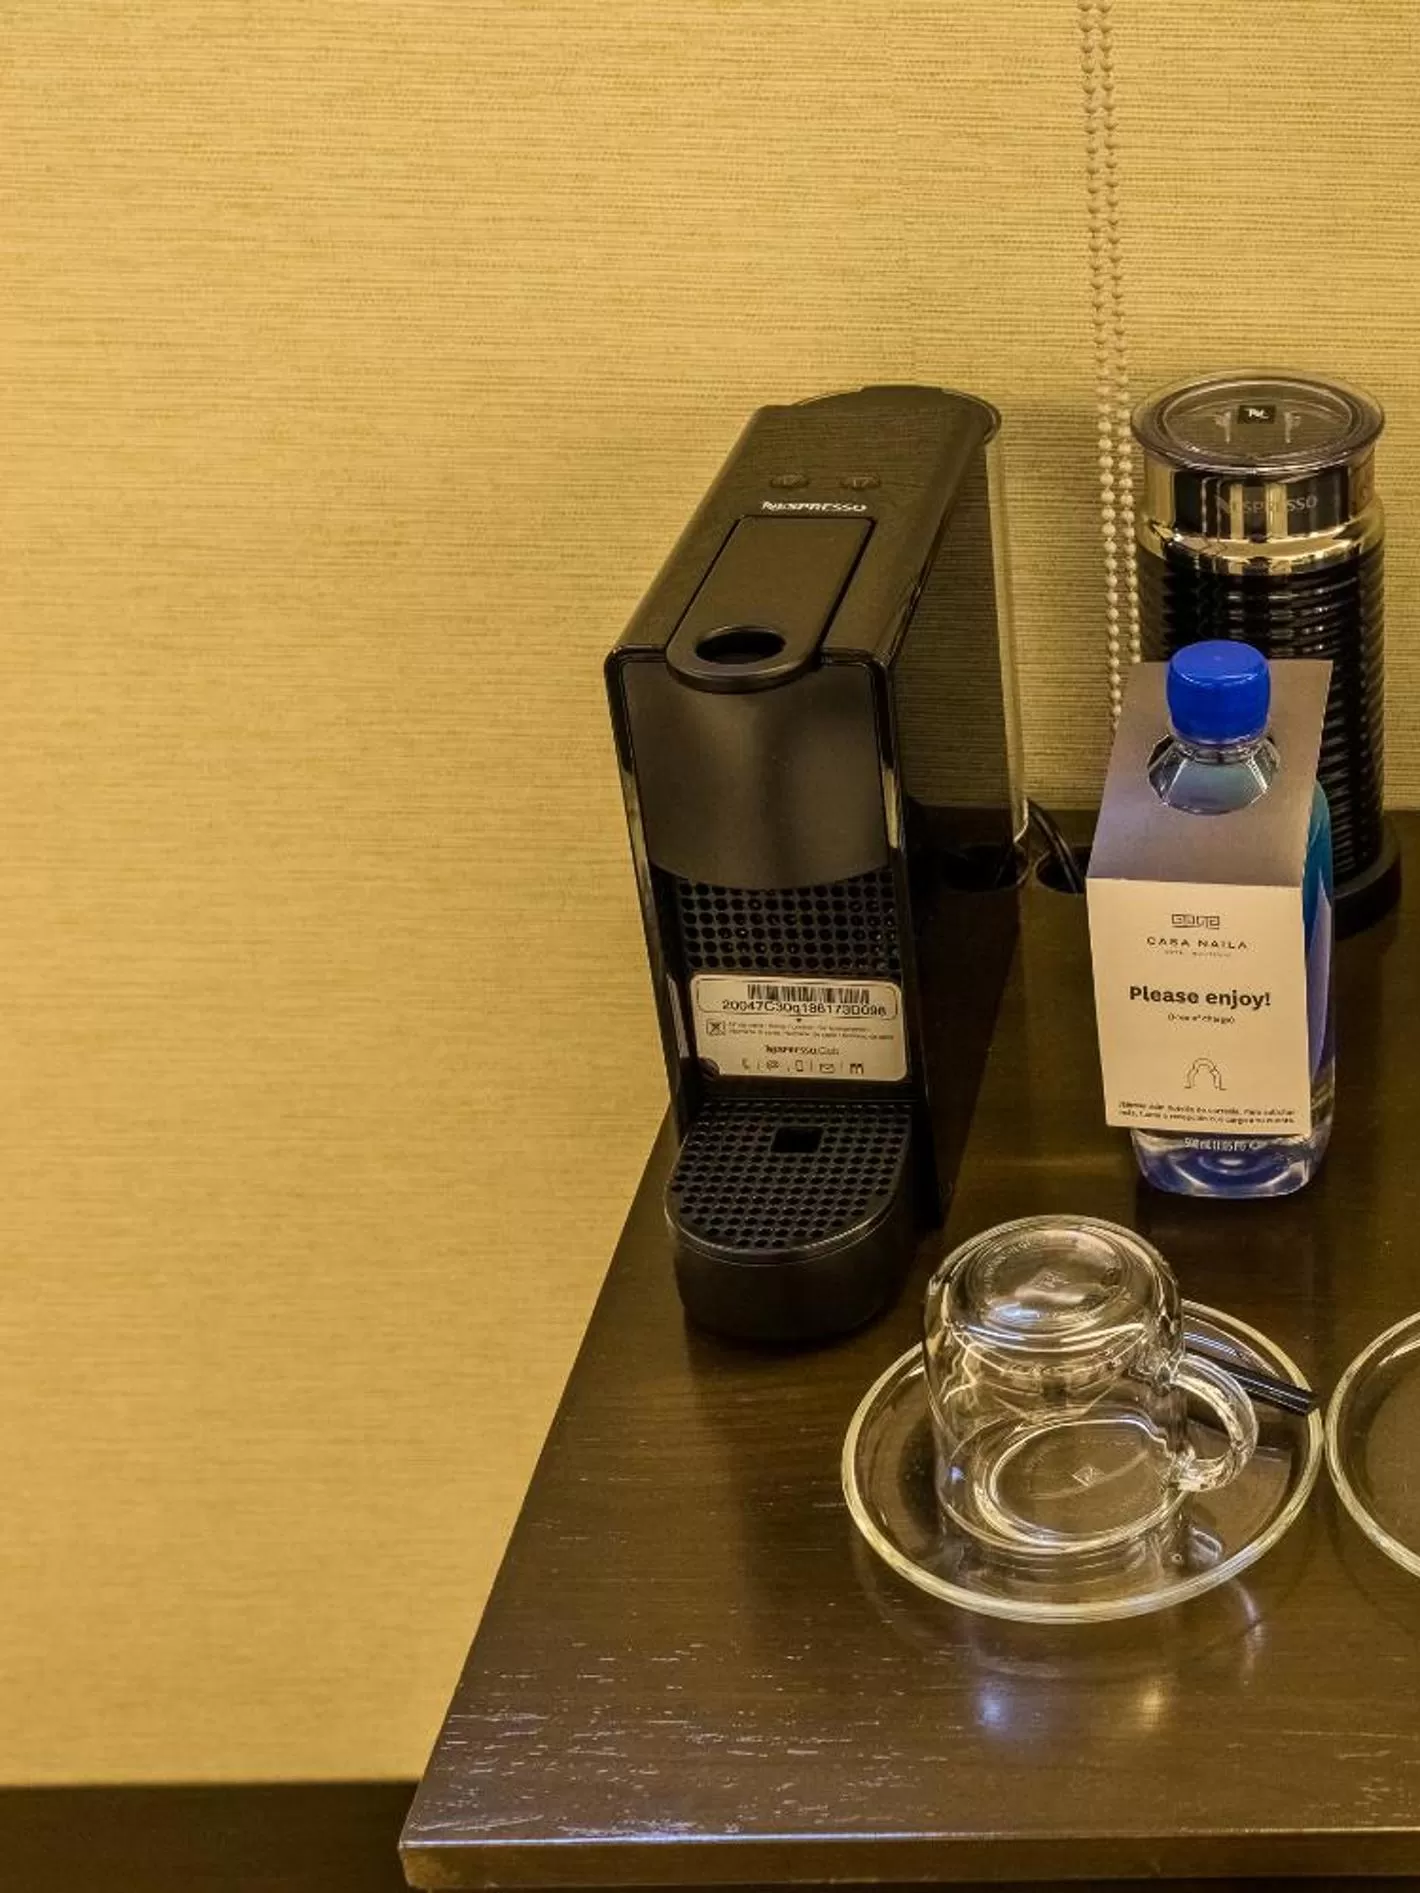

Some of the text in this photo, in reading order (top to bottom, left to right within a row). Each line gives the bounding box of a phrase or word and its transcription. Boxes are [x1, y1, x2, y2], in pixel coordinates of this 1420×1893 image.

[1215, 494, 1318, 514] NSPSSO
[1129, 985, 1272, 1011] Please enjoy!
